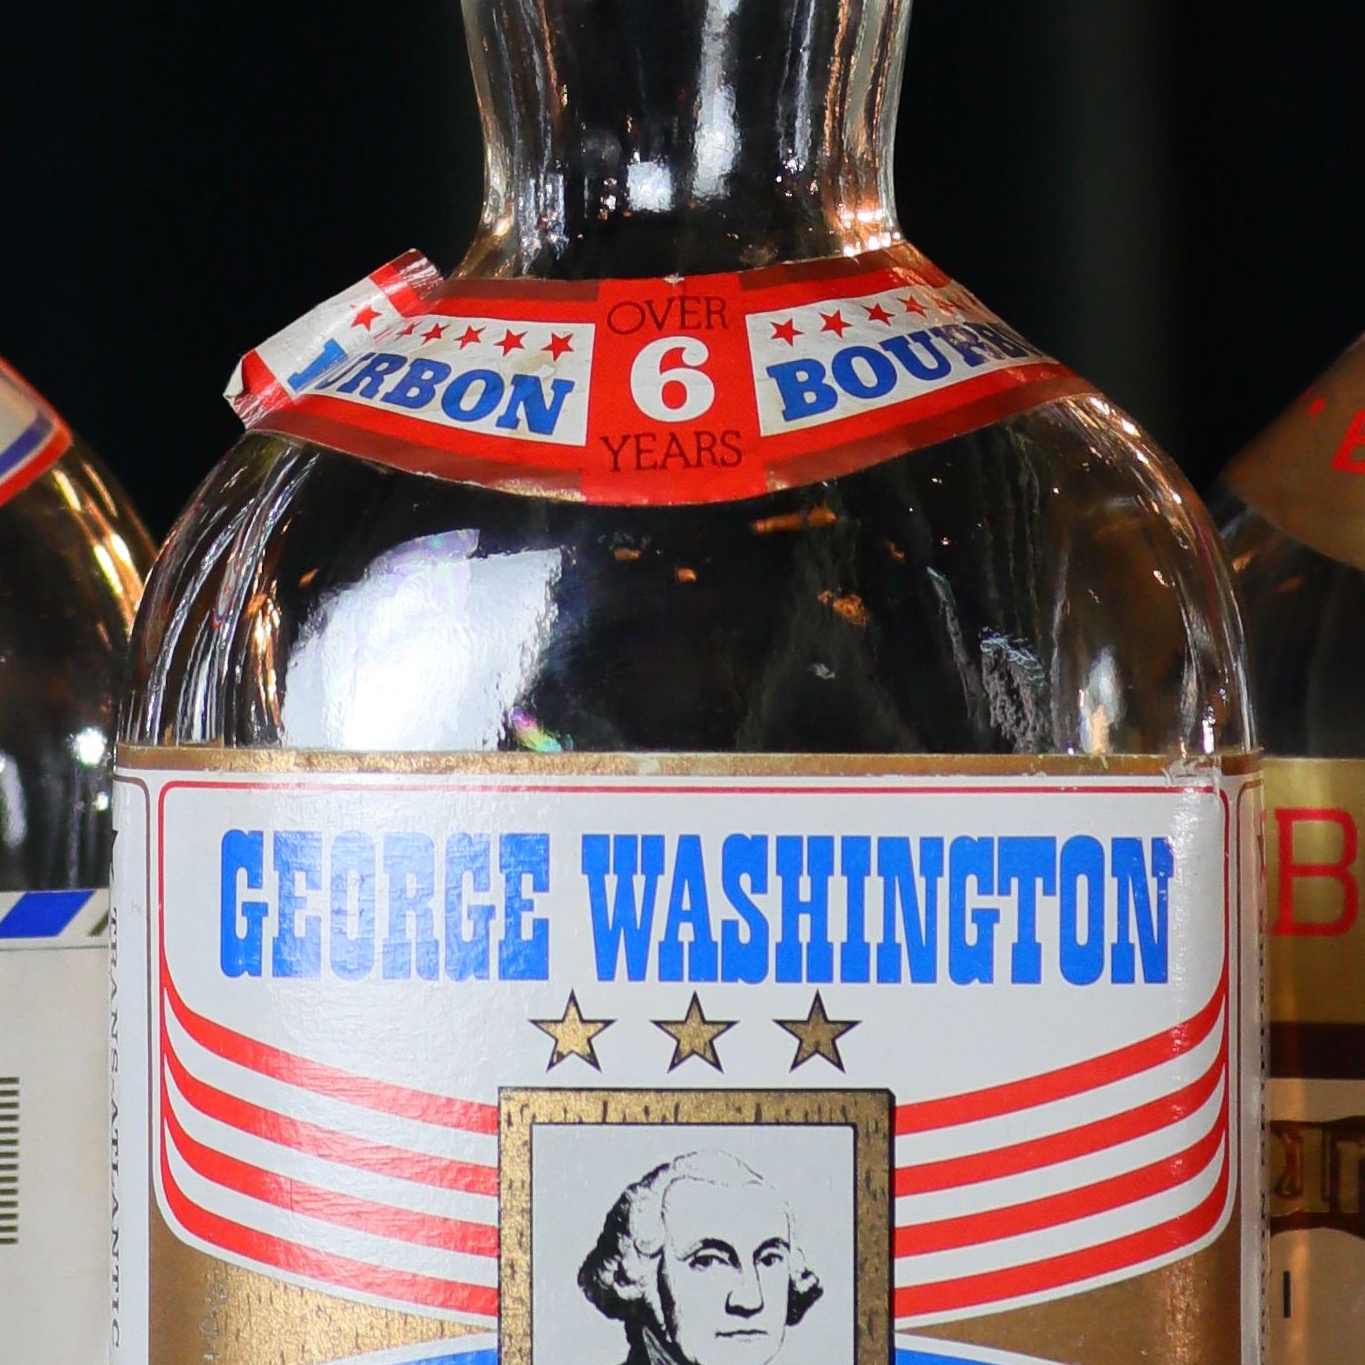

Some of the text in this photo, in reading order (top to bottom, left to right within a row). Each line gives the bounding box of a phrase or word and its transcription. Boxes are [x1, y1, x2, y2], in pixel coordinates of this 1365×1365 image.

[606, 294, 730, 333] OVER
[629, 336, 715, 422] 6
[600, 430, 742, 473] YEARS
[219, 829, 1175, 985] GEORGE WASHINGTON
